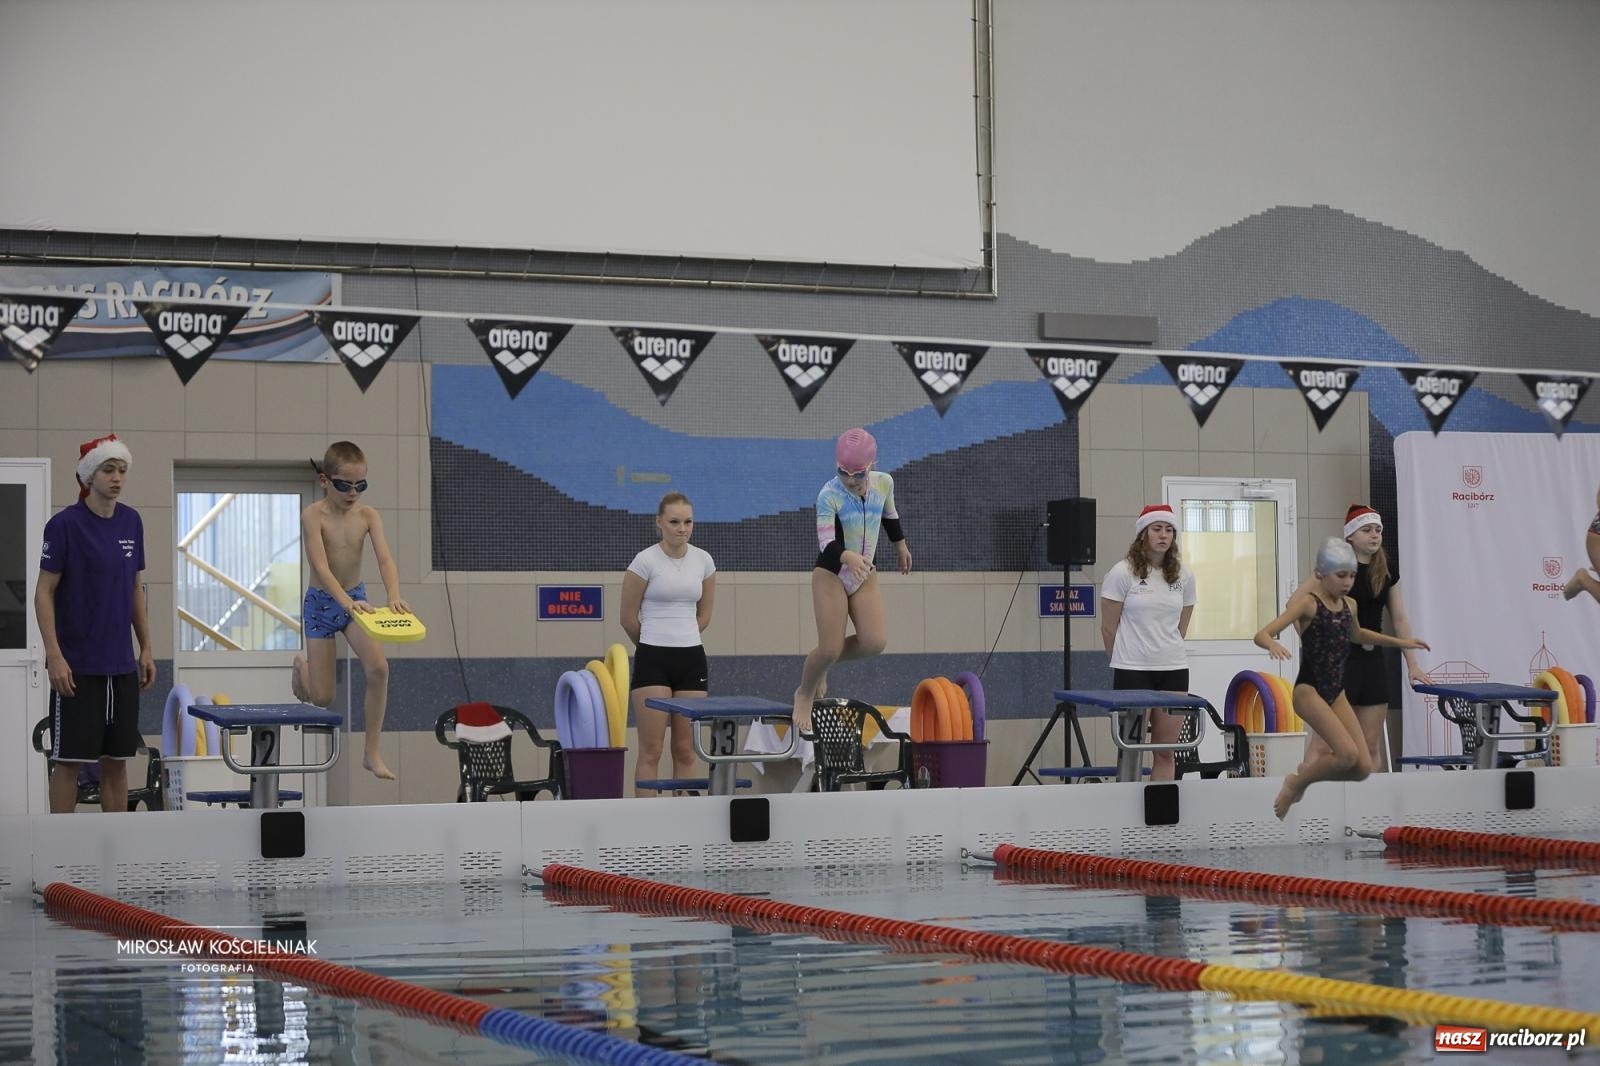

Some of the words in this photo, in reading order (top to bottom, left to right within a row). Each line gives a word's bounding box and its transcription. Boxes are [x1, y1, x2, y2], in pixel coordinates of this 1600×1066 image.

[0, 302, 59, 327] arena
[158, 311, 222, 335] arena
[332, 319, 395, 344] arena
[489, 325, 548, 351] arena
[634, 335, 691, 358] arena
[778, 342, 833, 365] arena
[914, 350, 967, 372] arena
[1047, 356, 1097, 378] arena
[1178, 363, 1226, 384] arena
[1300, 369, 1347, 389] arena
[1416, 375, 1459, 395] arena
[1536, 381, 1578, 400] arena
[1452, 491, 1495, 501] Racibórz
[559, 591, 581, 601] NIE
[1055, 590, 1079, 600] ZAAZ
[1532, 583, 1566, 591] Racibó
[547, 604, 593, 615] BIEGAJ
[1050, 602, 1085, 612] SKAANIA
[720, 720, 736, 756] 3
[1128, 714, 1143, 745] 4
[261, 730, 276, 767] 2
